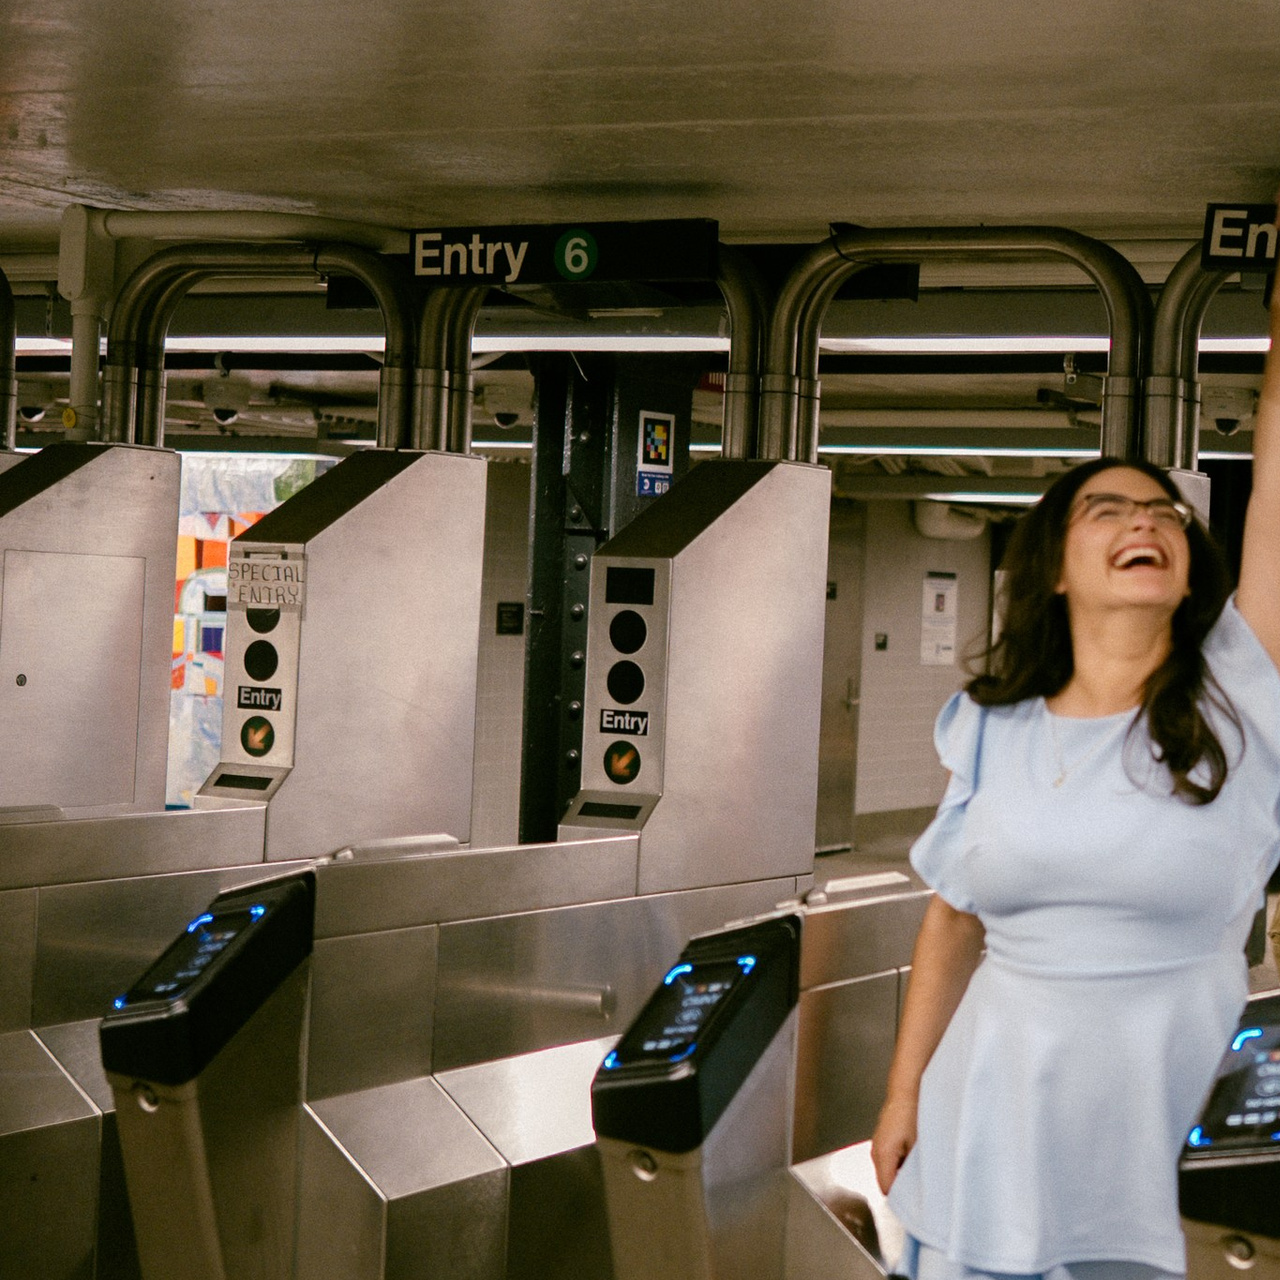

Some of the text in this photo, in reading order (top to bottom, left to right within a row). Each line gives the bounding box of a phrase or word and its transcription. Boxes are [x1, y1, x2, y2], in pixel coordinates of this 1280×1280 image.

[415, 233, 589, 283] Entry 6
[229, 562, 305, 583] SPECIAL
[238, 585, 300, 604] ENTRY
[240, 688, 281, 711] Entry
[602, 710, 648, 735] Entry
